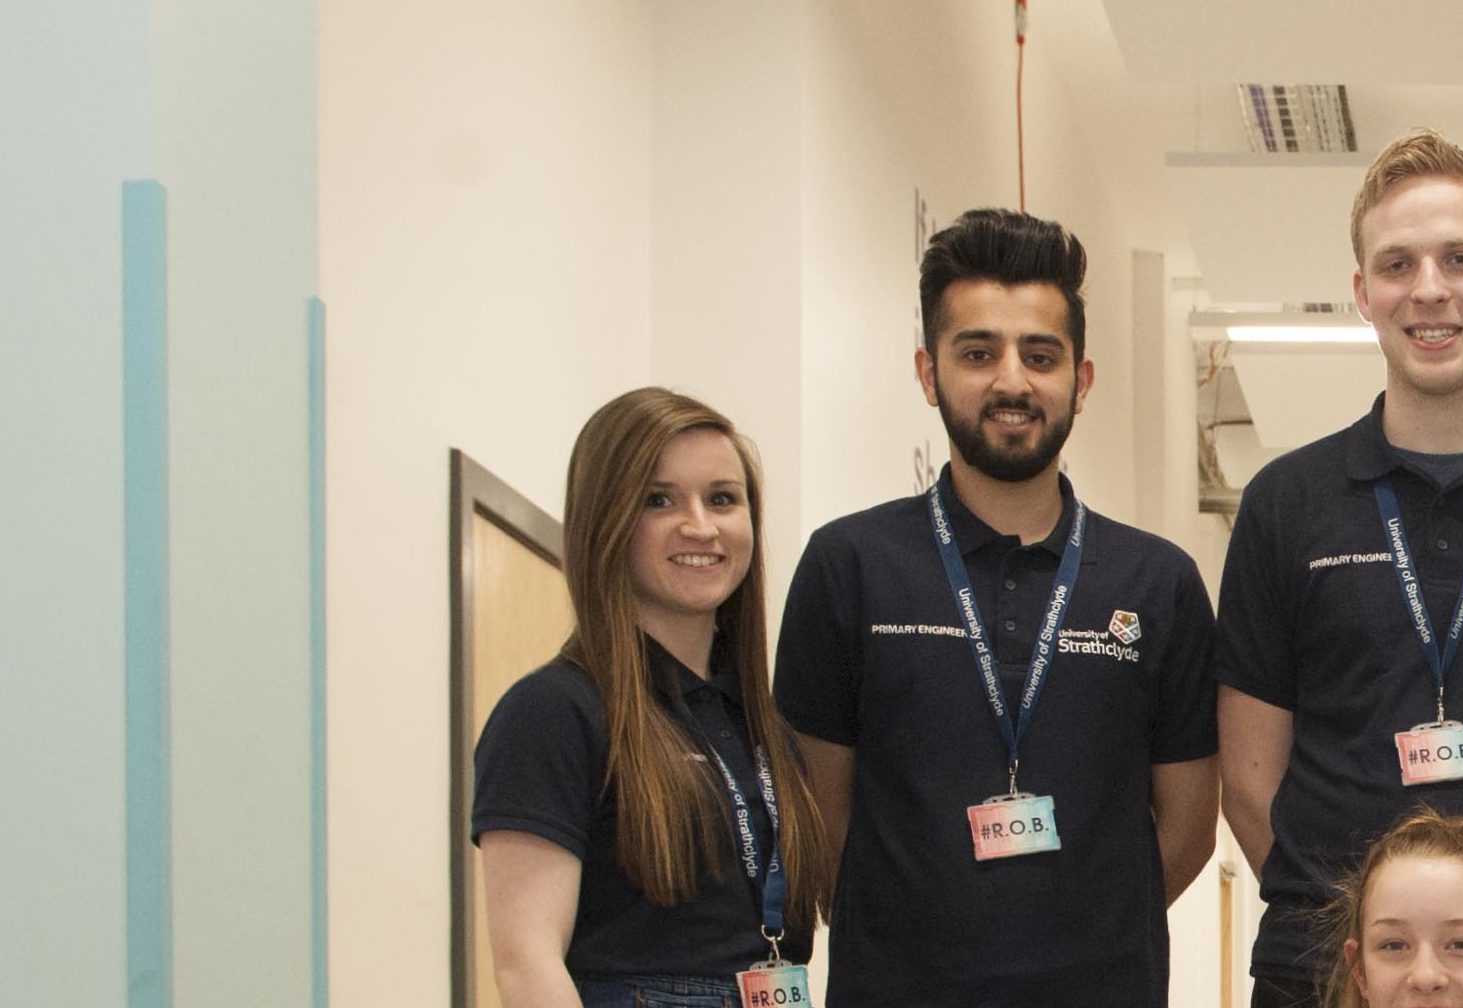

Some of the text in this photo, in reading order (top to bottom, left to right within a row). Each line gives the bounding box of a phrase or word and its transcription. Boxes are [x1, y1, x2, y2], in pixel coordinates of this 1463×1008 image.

[1309, 552, 1393, 570] PRIMARY ENGINEE
[1388, 517, 1431, 644] University of Strathclyde
[871, 624, 917, 634] PRIMARY
[1058, 629, 1101, 641] University
[958, 588, 1004, 716] University of Strathclyde
[1022, 585, 1067, 709] University of Strathclyde
[1058, 639, 1139, 662] Strathclyde
[734, 794, 746, 806] of
[981, 817, 1049, 840] #R.O.B.
[737, 809, 759, 878] Strathclyde
[751, 986, 806, 1008] #R.O.B.
